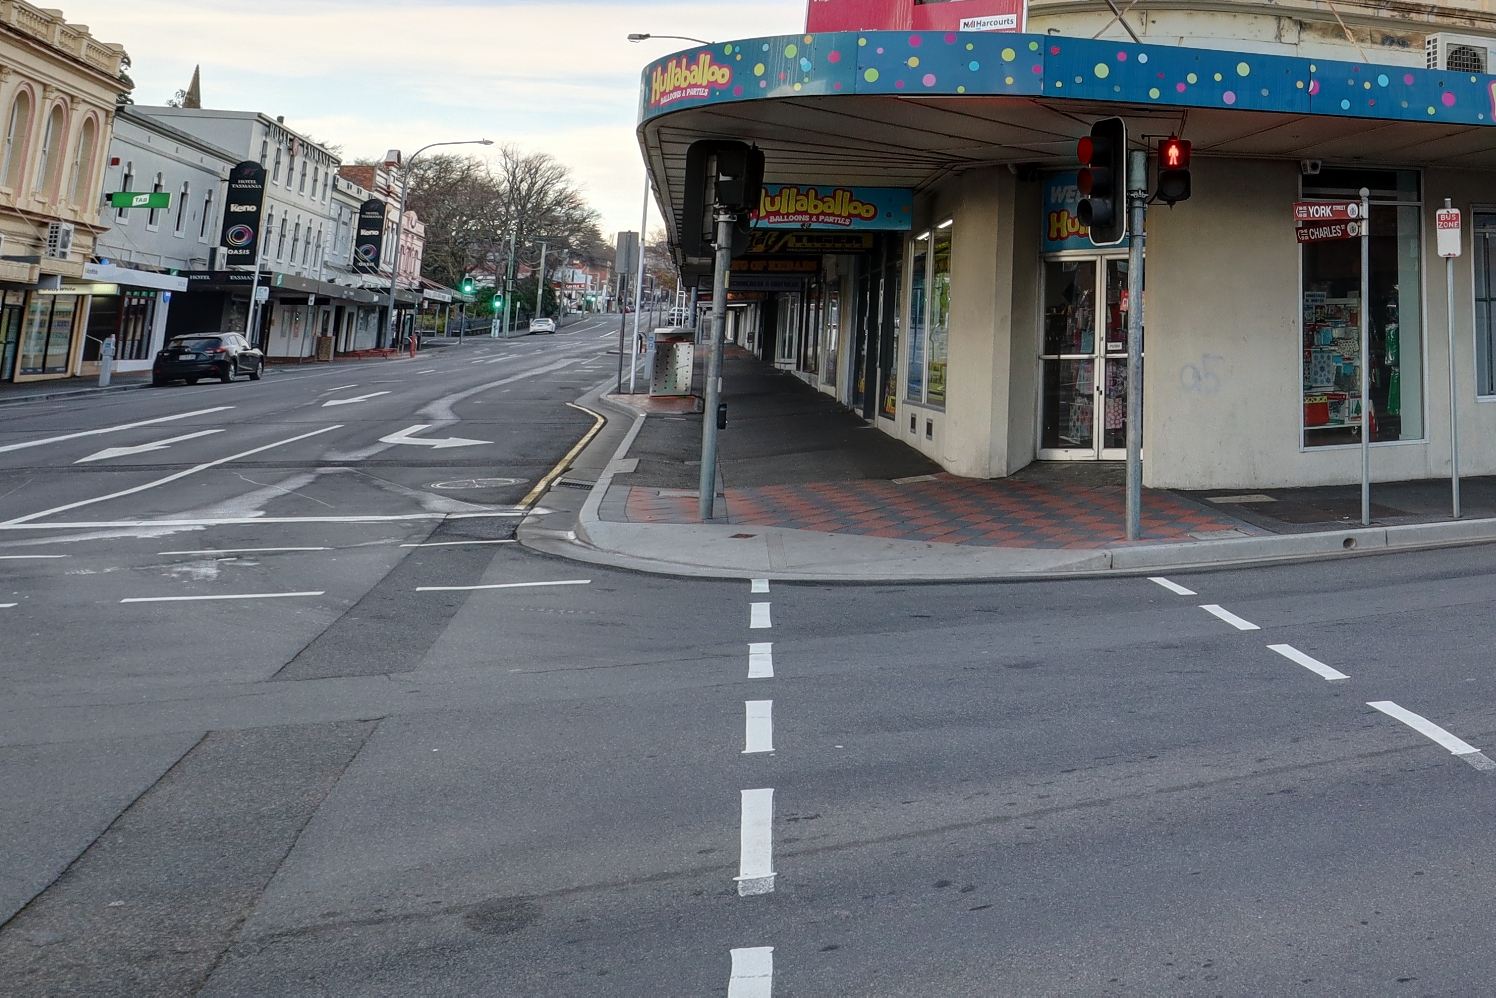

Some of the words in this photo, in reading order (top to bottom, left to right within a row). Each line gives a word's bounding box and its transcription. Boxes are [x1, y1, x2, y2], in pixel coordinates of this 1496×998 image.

[651, 54, 730, 104] Hullaballoo
[660, 90, 682, 105] BALLOONS
[686, 88, 709, 97] PARTIES
[230, 204, 257, 212] Keno
[1308, 205, 1333, 218] YORK
[769, 214, 810, 223] BALLOONS
[818, 215, 851, 225] PARTIES
[1440, 213, 1457, 221] BUS
[1438, 221, 1459, 229] ZONE
[1308, 225, 1342, 240] CHARLES
